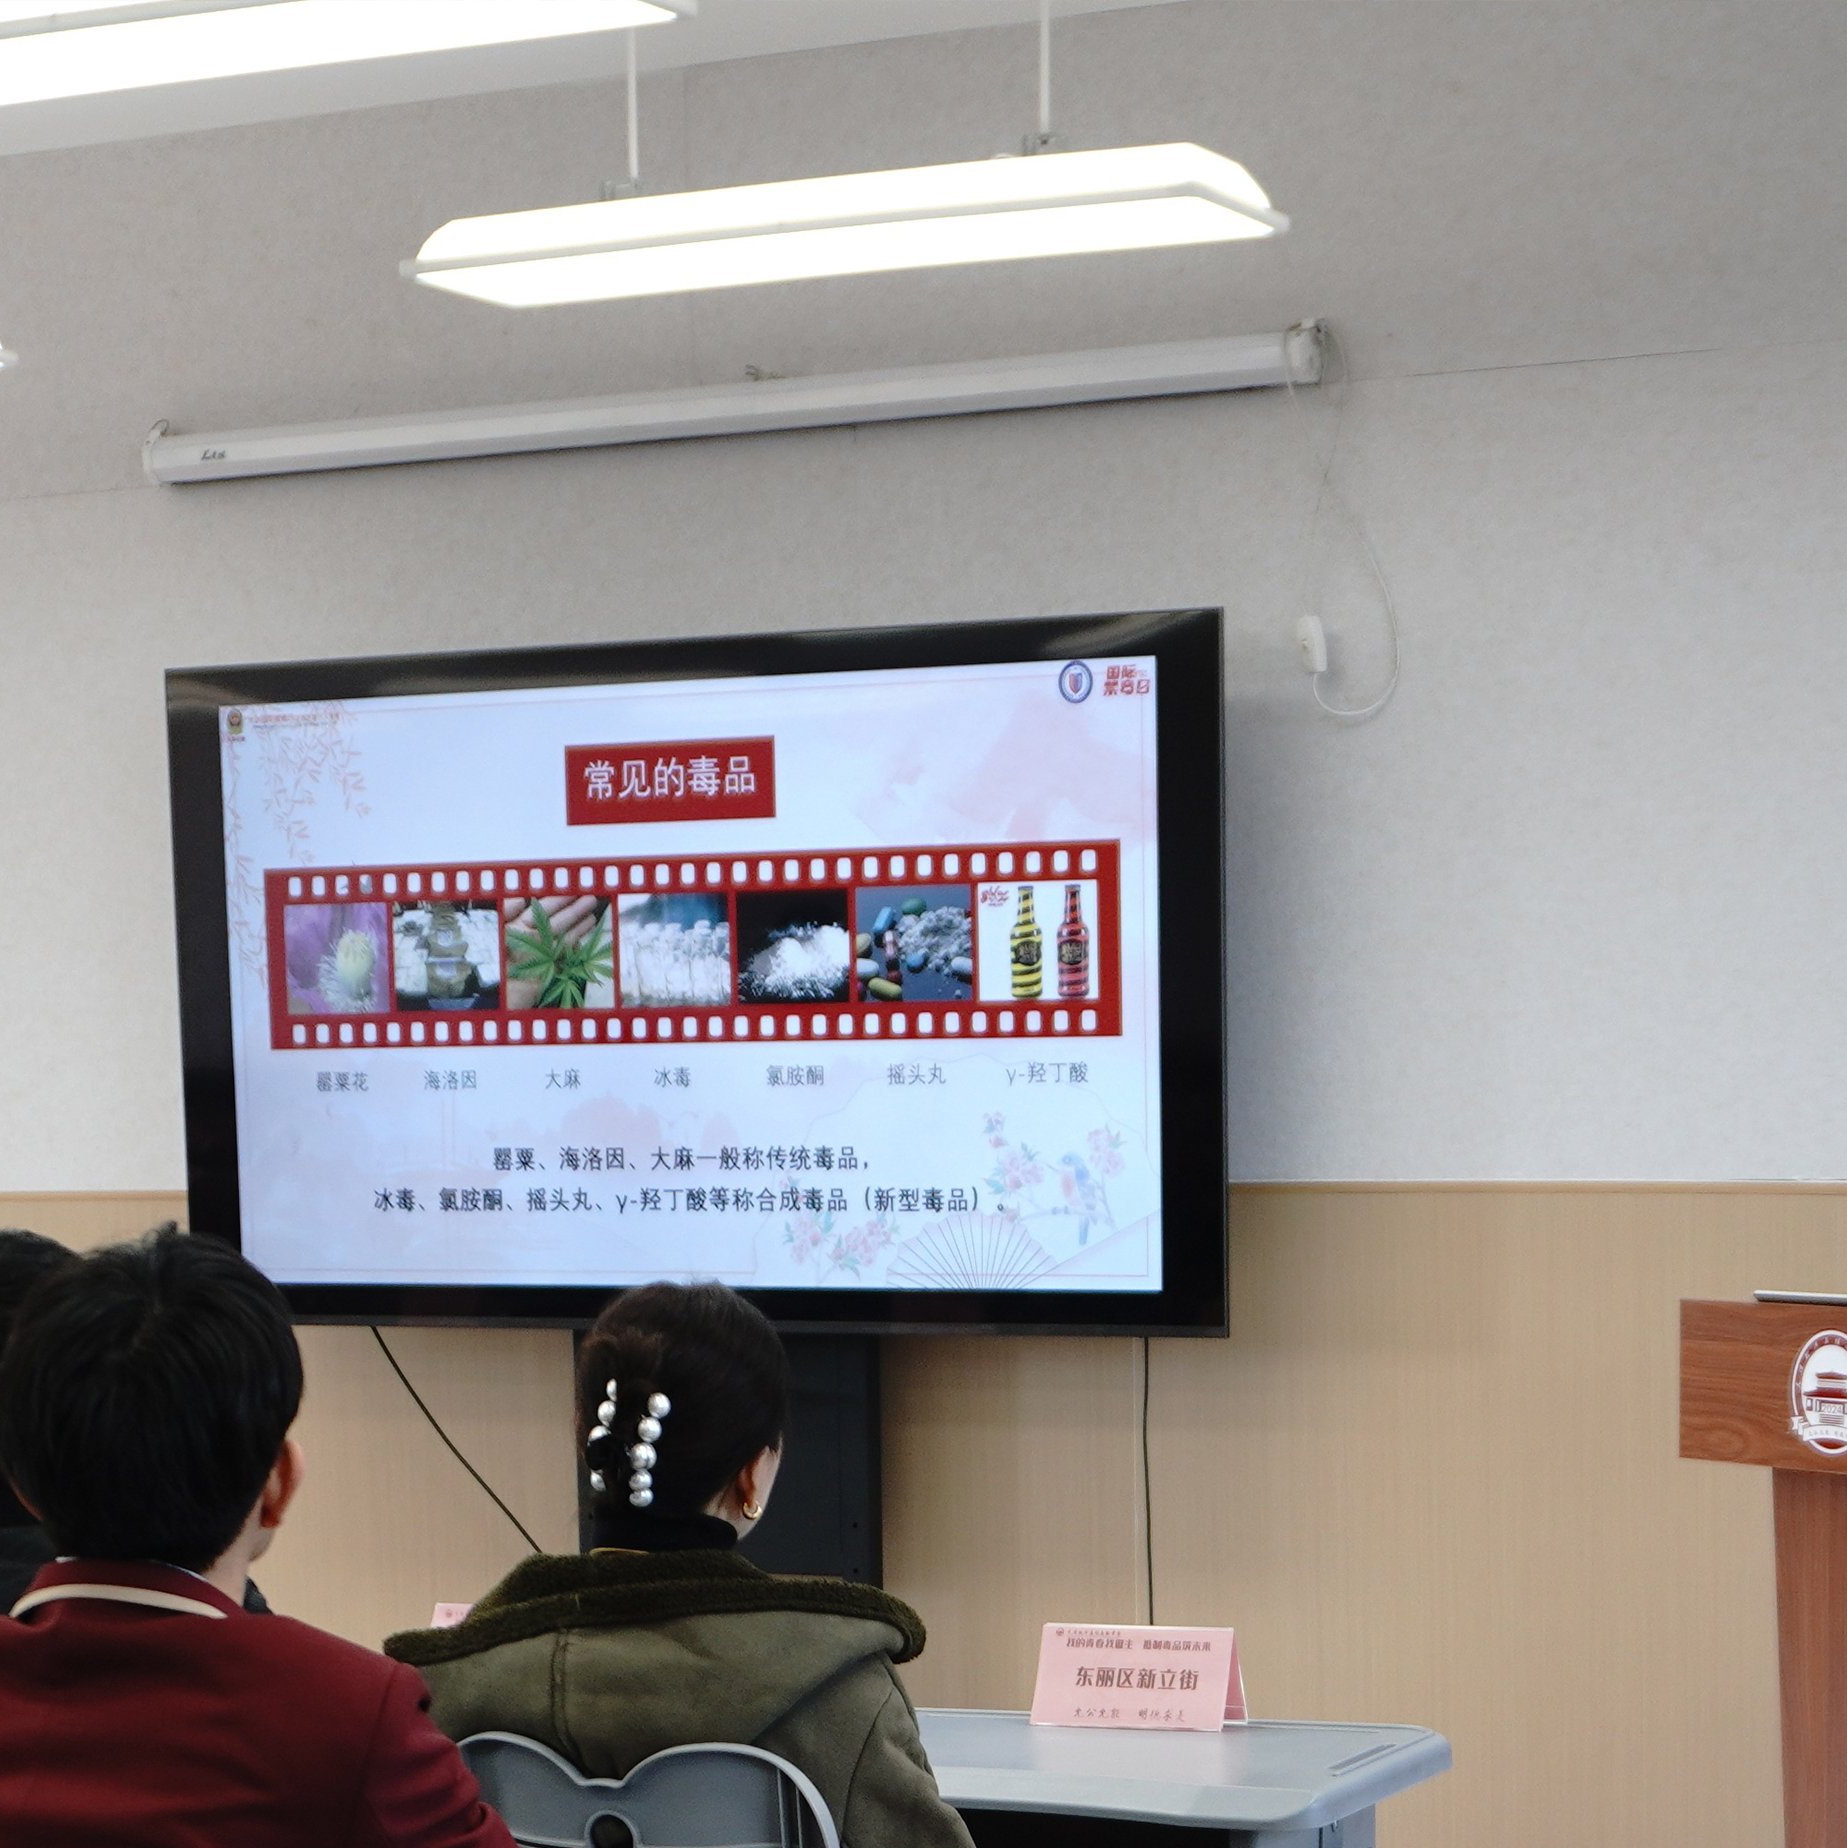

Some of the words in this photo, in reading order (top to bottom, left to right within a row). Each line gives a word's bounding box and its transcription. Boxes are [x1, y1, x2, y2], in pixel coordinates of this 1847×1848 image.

[584, 755, 756, 799] 常见的毒品
[316, 1071, 369, 1093] 罂粟花
[423, 1070, 478, 1091] 海洛因
[544, 1069, 581, 1090] 大麻
[654, 1066, 692, 1088] 冰毒
[766, 1064, 825, 1087] 氯胺酮
[887, 1063, 946, 1086] 摇头丸
[1075, 1666, 1199, 1691] 东丽区新立街
